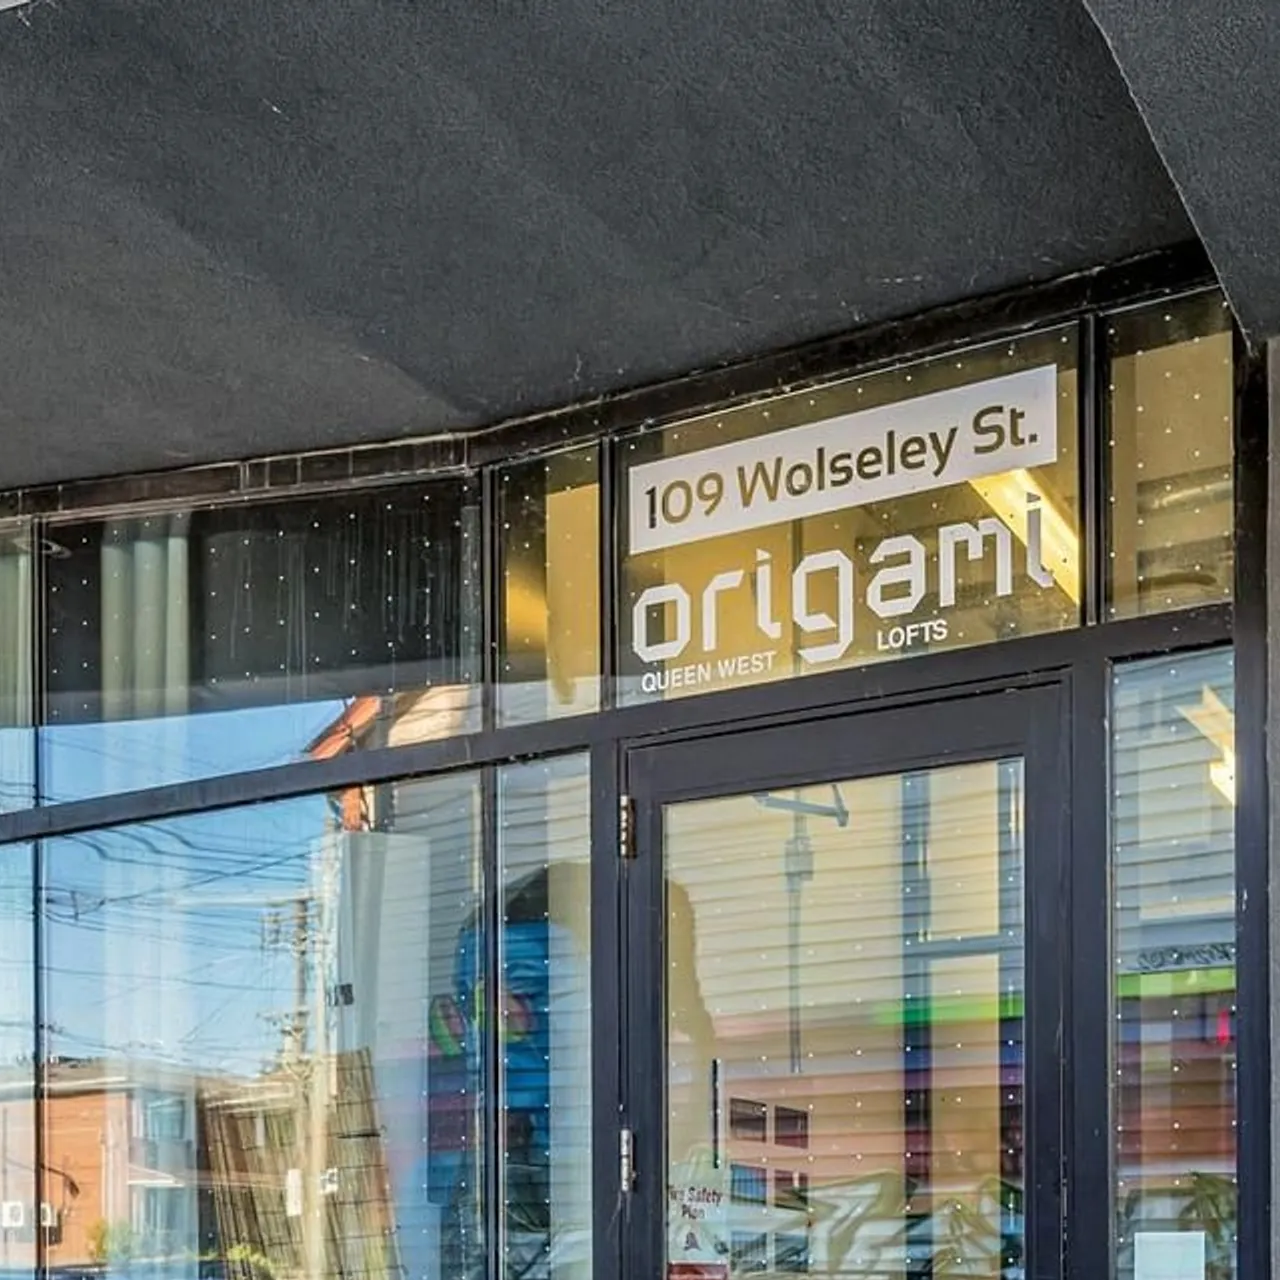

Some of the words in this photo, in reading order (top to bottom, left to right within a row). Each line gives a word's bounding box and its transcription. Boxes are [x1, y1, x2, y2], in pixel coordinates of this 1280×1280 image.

[644, 472, 722, 530] 109
[736, 426, 960, 504] Wolseley
[972, 404, 1039, 457] St.
[632, 491, 1056, 666] origami
[641, 662, 712, 694] QUEEN
[718, 650, 777, 679] WEST
[876, 618, 949, 651] LOFTS
